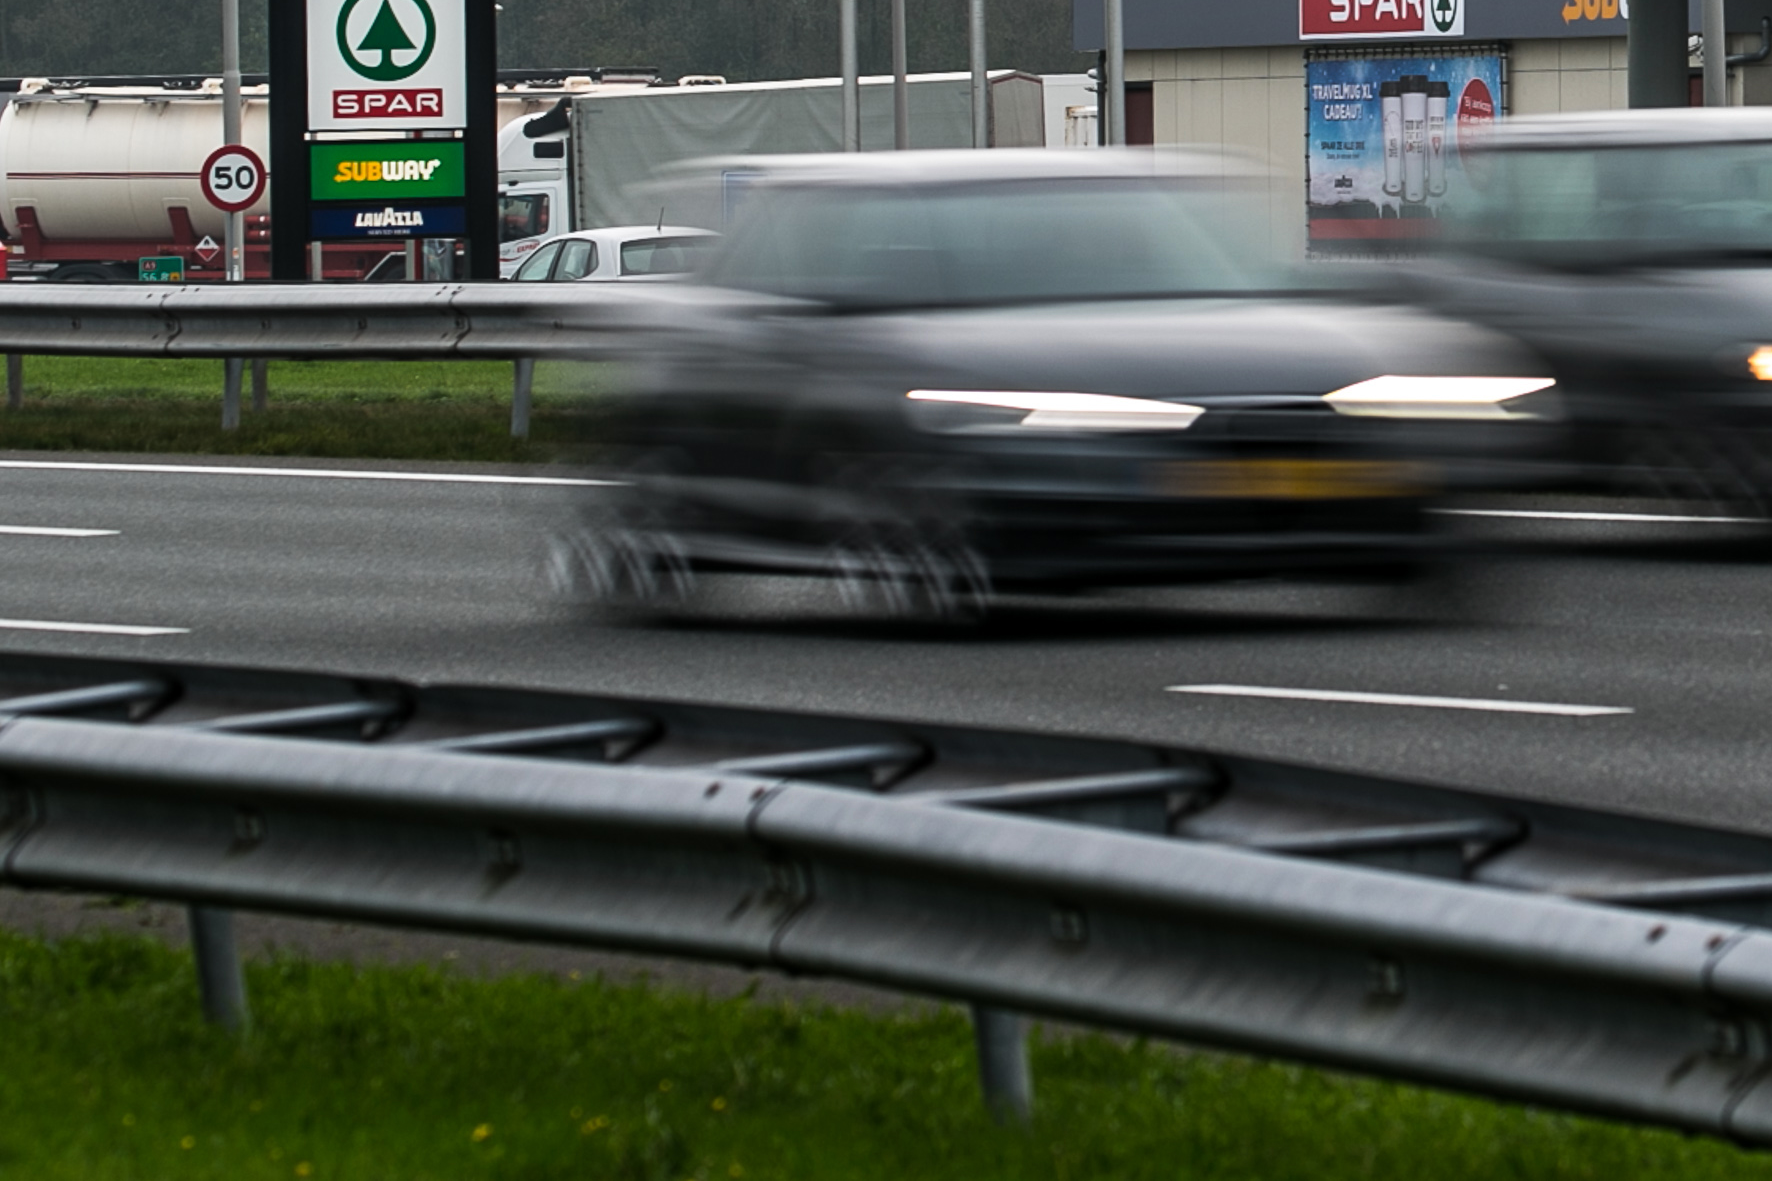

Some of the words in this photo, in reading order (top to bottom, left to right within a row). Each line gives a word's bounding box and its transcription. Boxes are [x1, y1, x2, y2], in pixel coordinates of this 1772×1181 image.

[337, 93, 440, 114] SPAR
[214, 165, 255, 190] 50
[334, 158, 441, 183] SUBWAY
[355, 207, 424, 227] LAVAZZA
